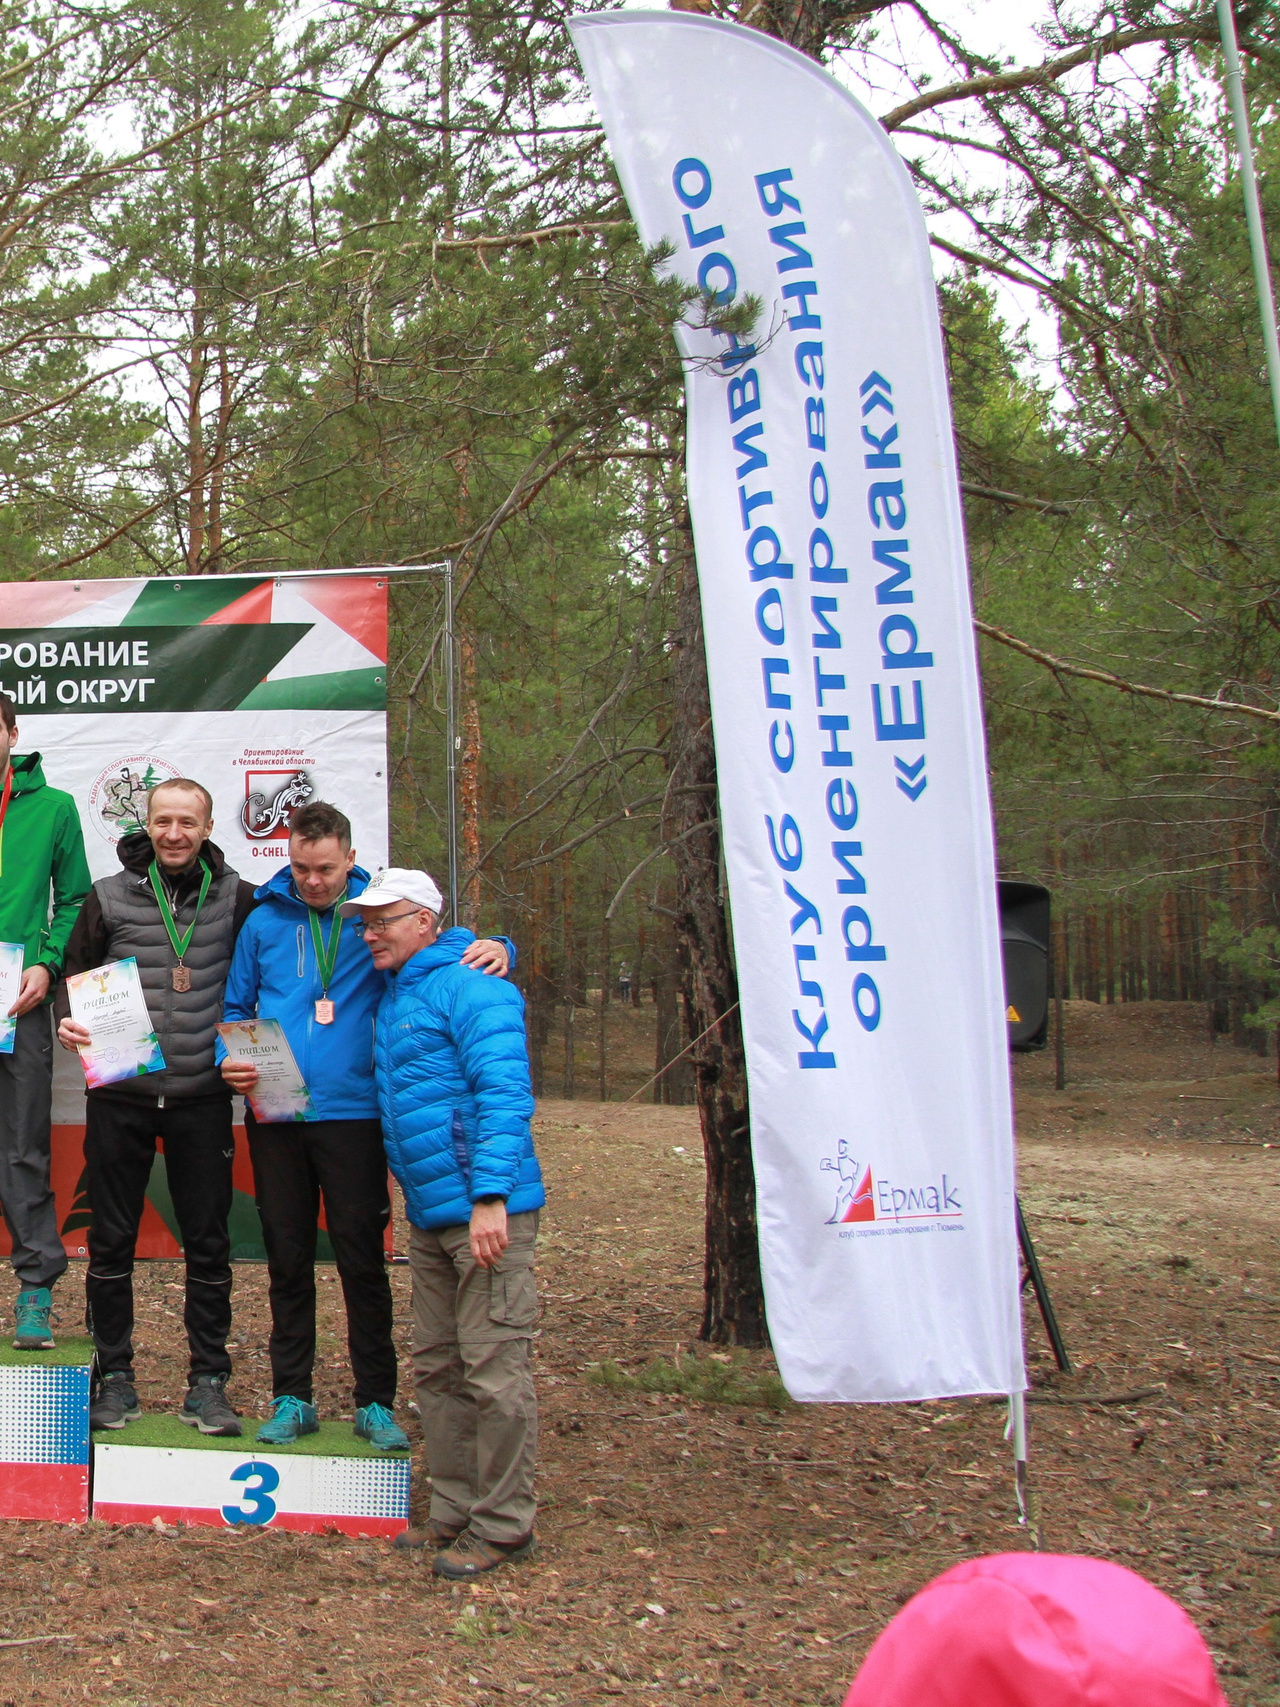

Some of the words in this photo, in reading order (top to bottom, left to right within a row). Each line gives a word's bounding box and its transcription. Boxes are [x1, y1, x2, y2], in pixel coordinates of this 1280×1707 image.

[672, 158, 794, 773] спортивного
[859, 370, 933, 802] «Ермак»
[754, 168, 887, 1032] ориентирования
[56, 678, 155, 704] ОКРУГ
[238, 757, 284, 766] Челябинской
[285, 756, 316, 765] области
[243, 748, 305, 758] Ориентирование
[151, 757, 181, 778] ОРИЕНТИР
[252, 847, 290, 858] O-CHEL.
[764, 813, 836, 1069] Клуб
[81, 990, 130, 1010] ДИПЛОМ
[237, 1045, 280, 1056] ДИПЛОМ
[877, 1173, 962, 1223] Ермак
[221, 1460, 280, 1525] 3
